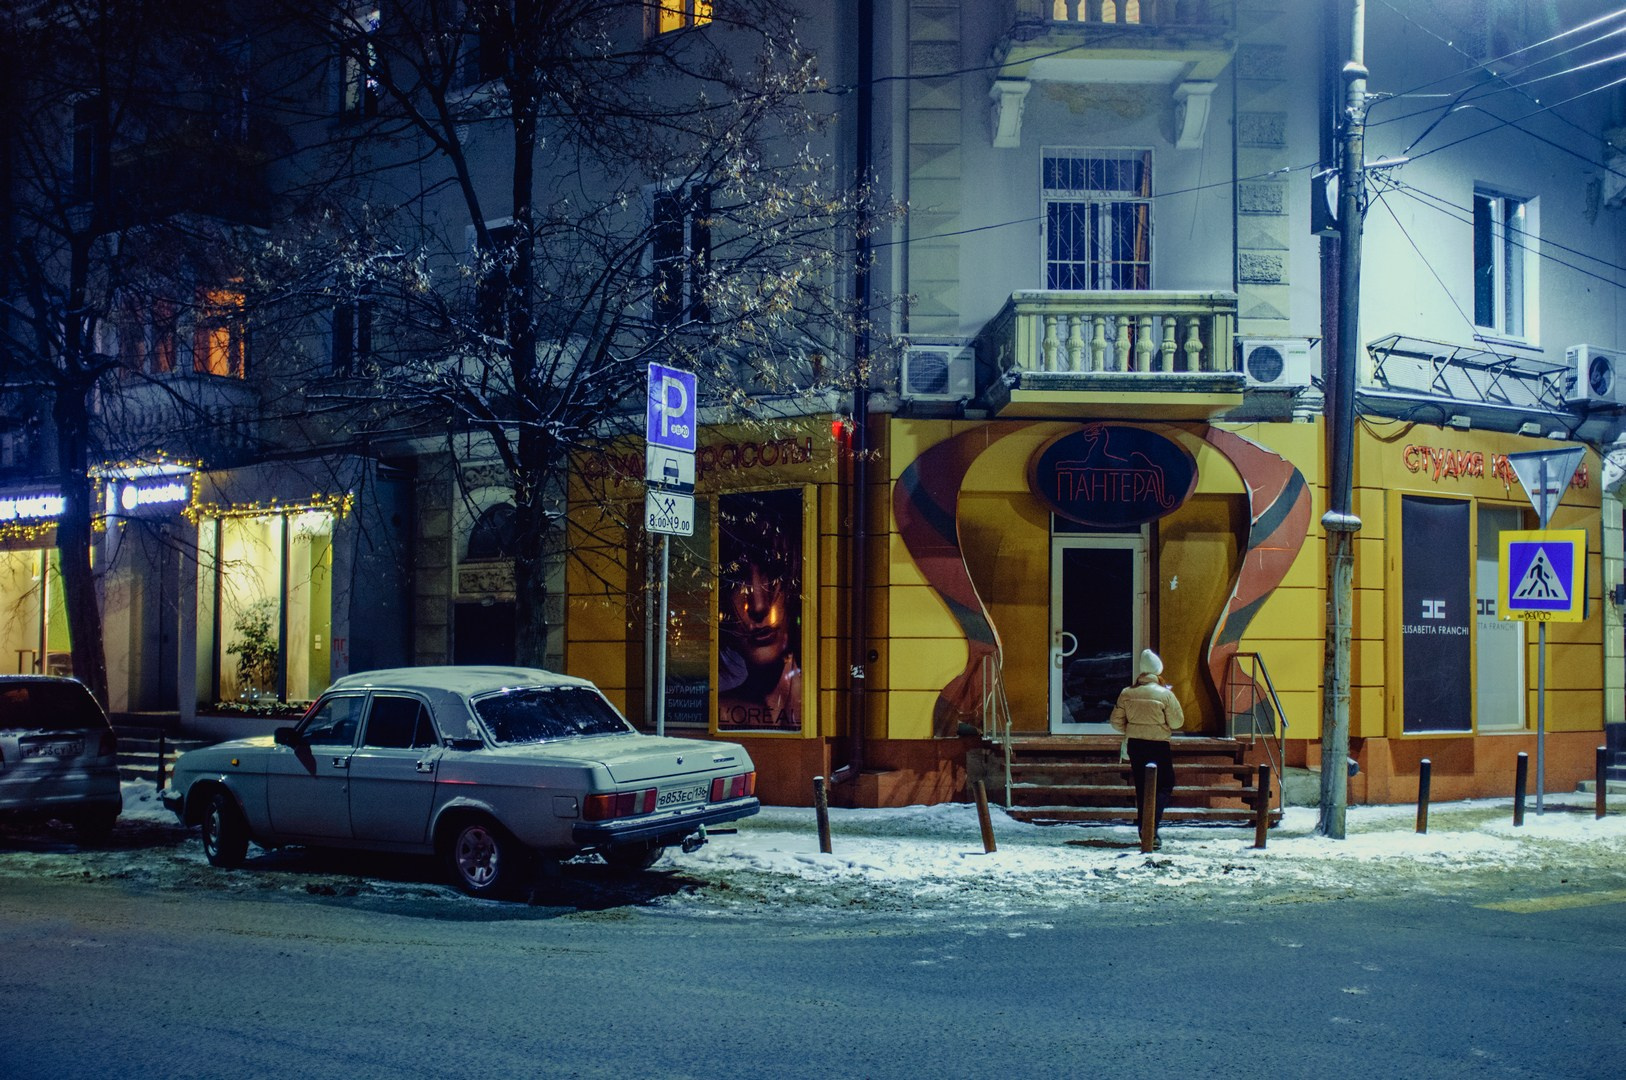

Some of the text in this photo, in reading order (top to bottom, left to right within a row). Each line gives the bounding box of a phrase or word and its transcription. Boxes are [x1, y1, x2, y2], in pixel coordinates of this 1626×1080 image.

[661, 375, 688, 437] P
[697, 436, 812, 481] расоты
[1057, 471, 1159, 502] ПАНТЕРА
[1402, 624, 1436, 635] ELISABETTA
[1438, 625, 1469, 636] FRANCHI
[668, 698, 702, 708] БИКИНИ
[694, 786, 706, 797] 136
